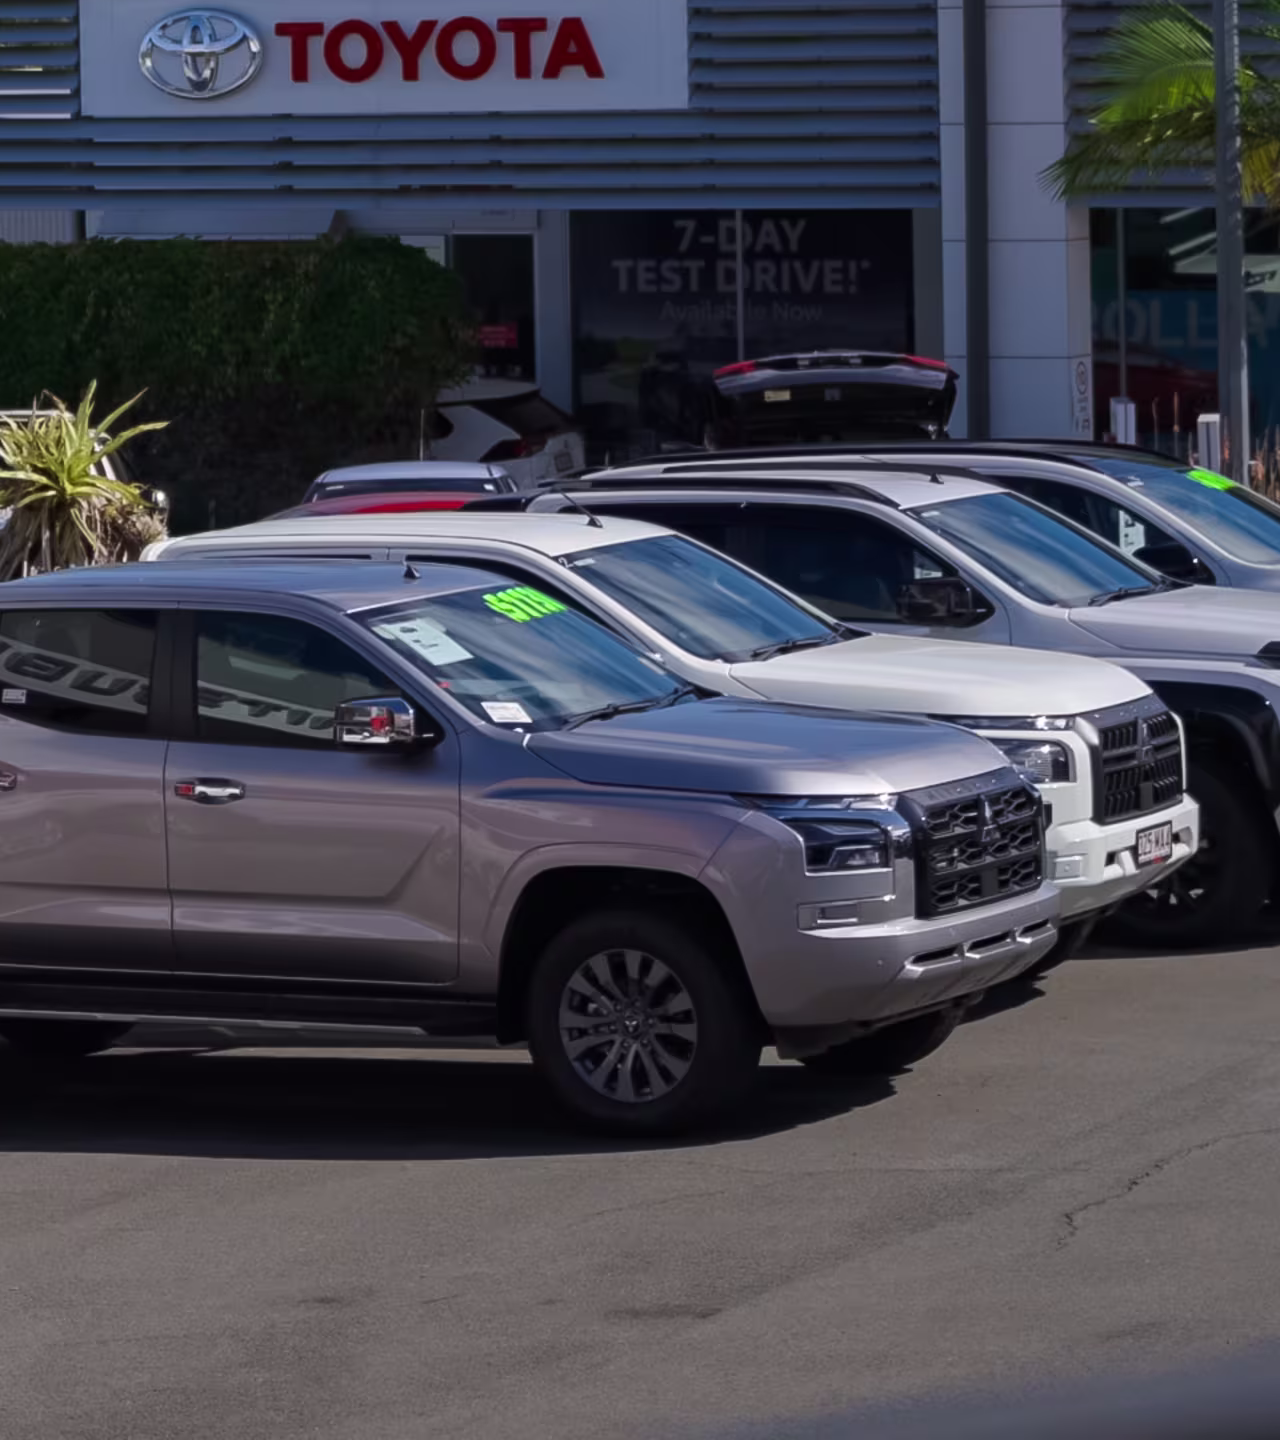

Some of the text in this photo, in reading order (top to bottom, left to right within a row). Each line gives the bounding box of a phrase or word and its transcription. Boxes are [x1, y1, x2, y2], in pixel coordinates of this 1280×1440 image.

[275, 16, 604, 82] TOYOTA
[673, 219, 806, 252] 7-DAY
[612, 260, 704, 293] TEST
[773, 301, 822, 322] Now
